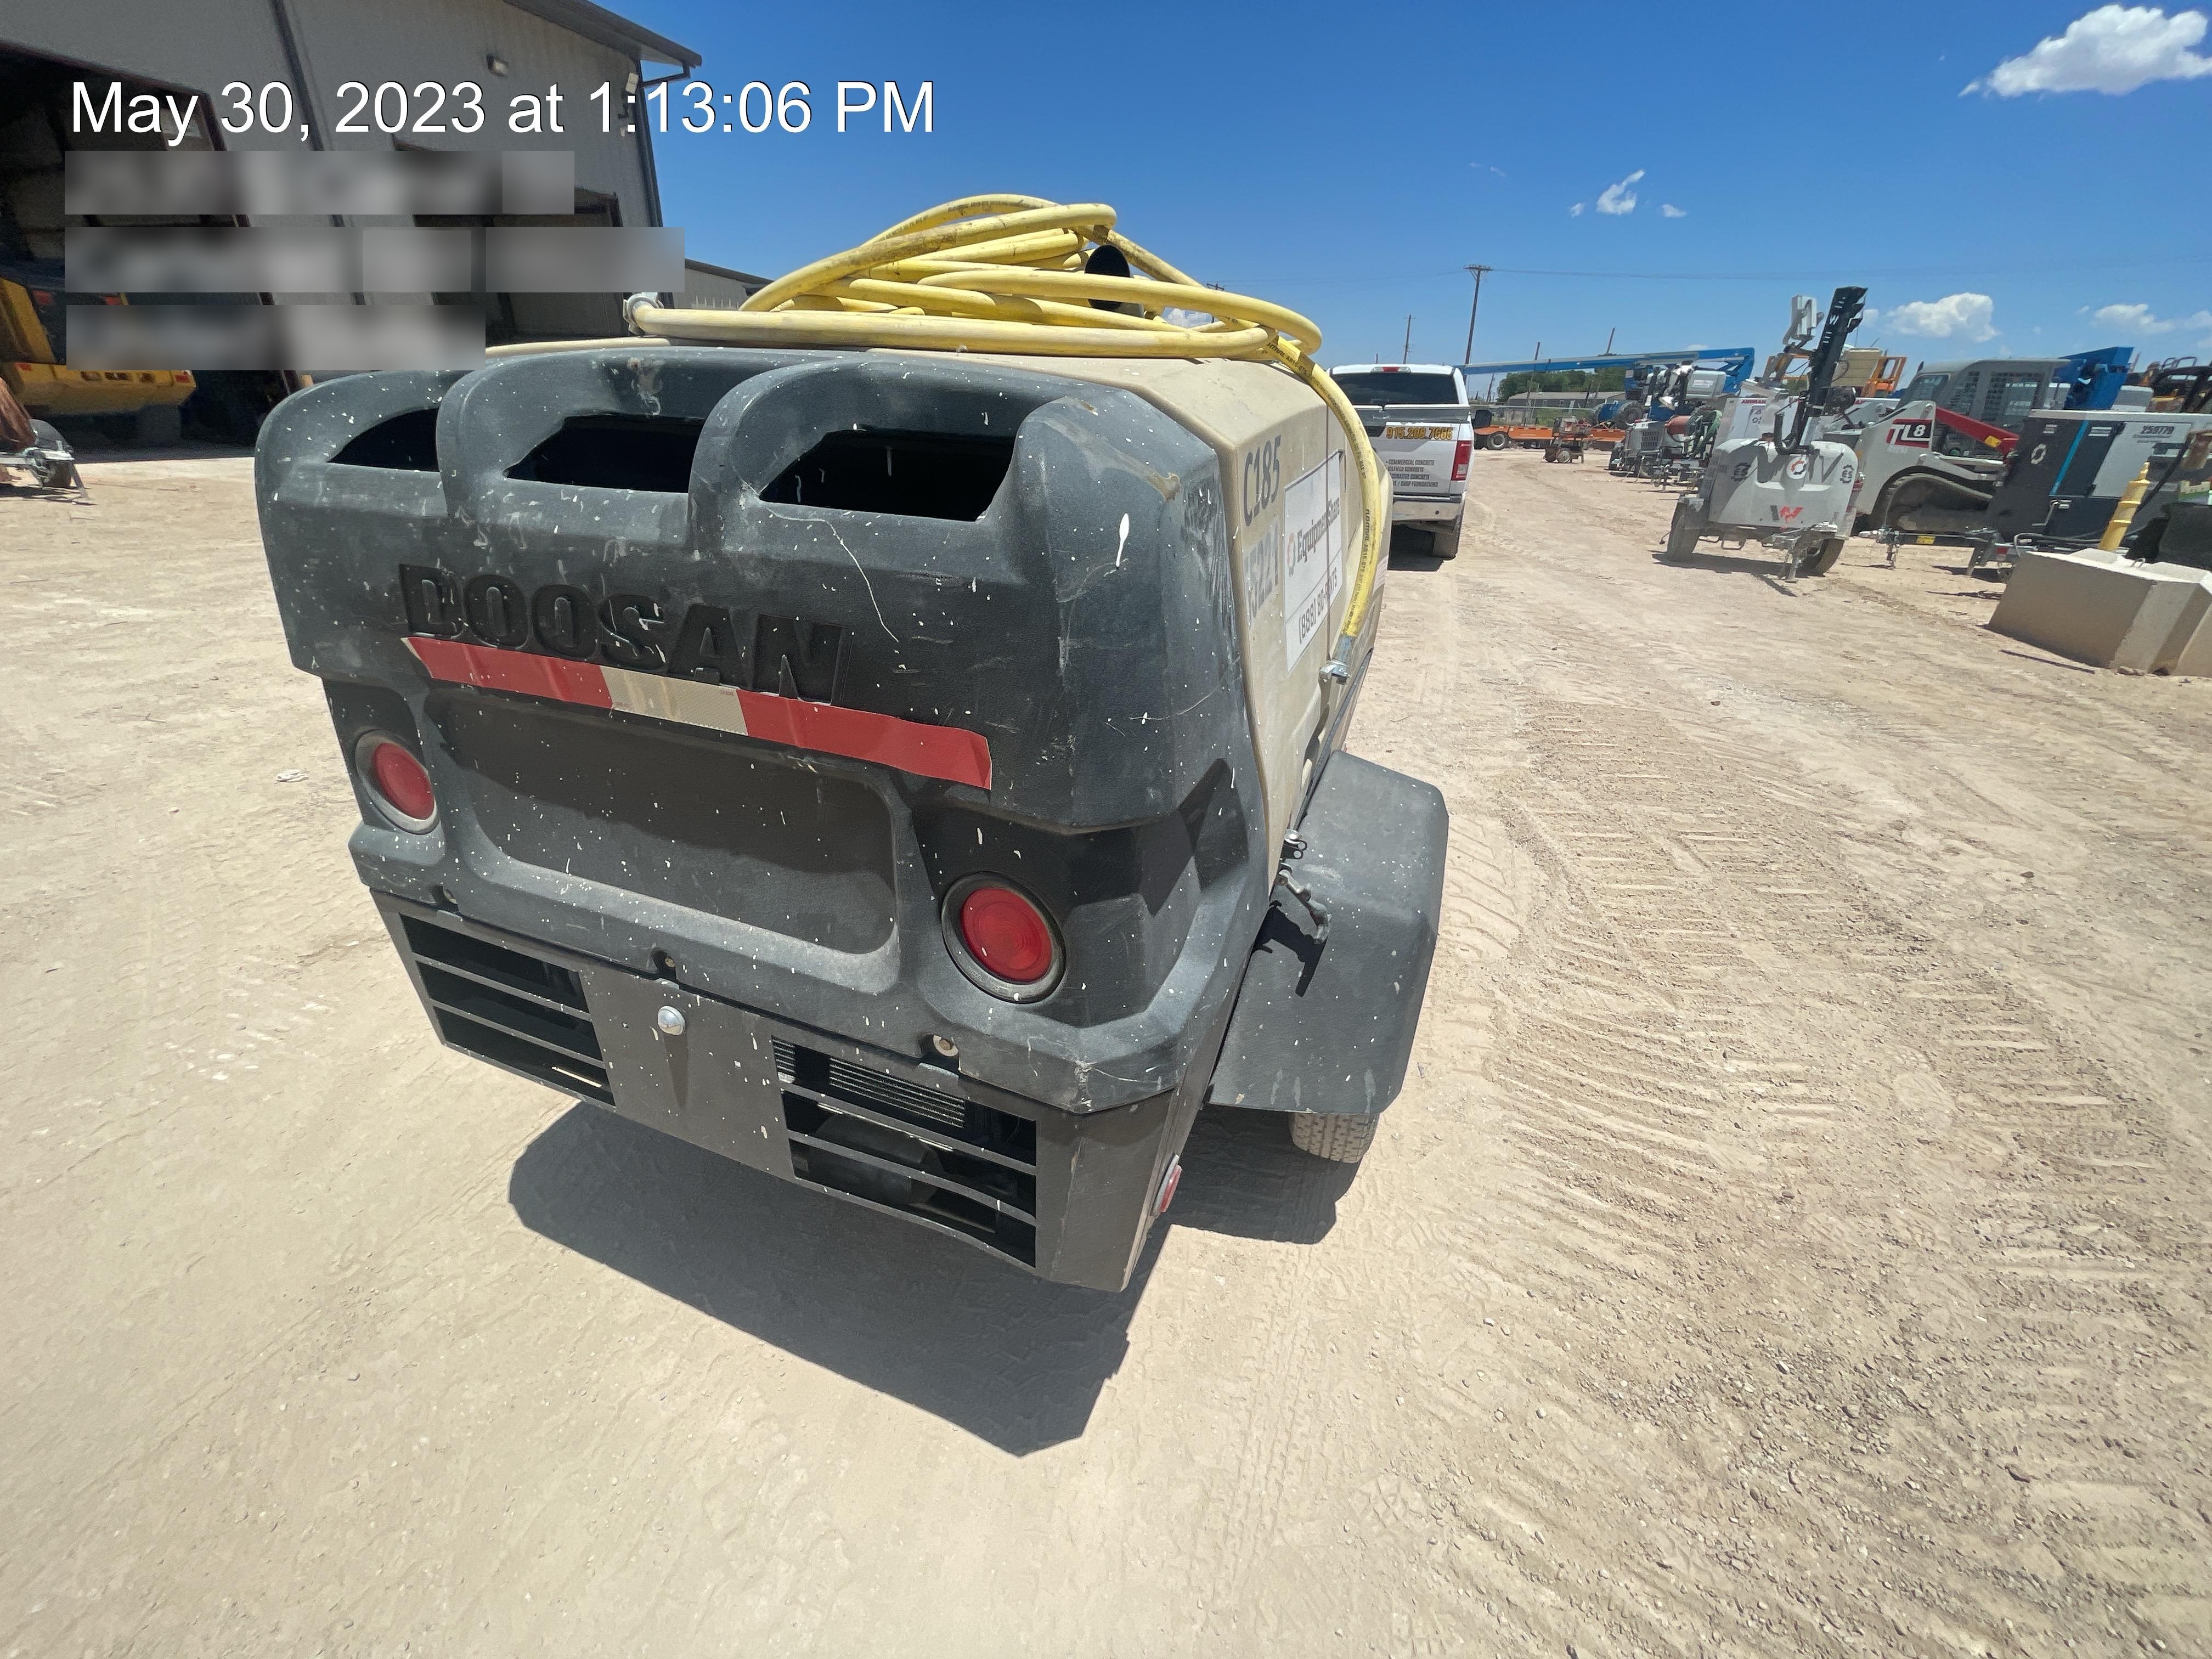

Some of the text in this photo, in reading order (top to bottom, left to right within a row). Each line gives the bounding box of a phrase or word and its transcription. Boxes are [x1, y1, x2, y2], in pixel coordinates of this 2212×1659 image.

[1243, 434, 1282, 527] C185
[1296, 496, 1340, 564] EquipmenShare
[399, 564, 854, 706] DOOSAN
[1299, 598, 1317, 644] (888)
